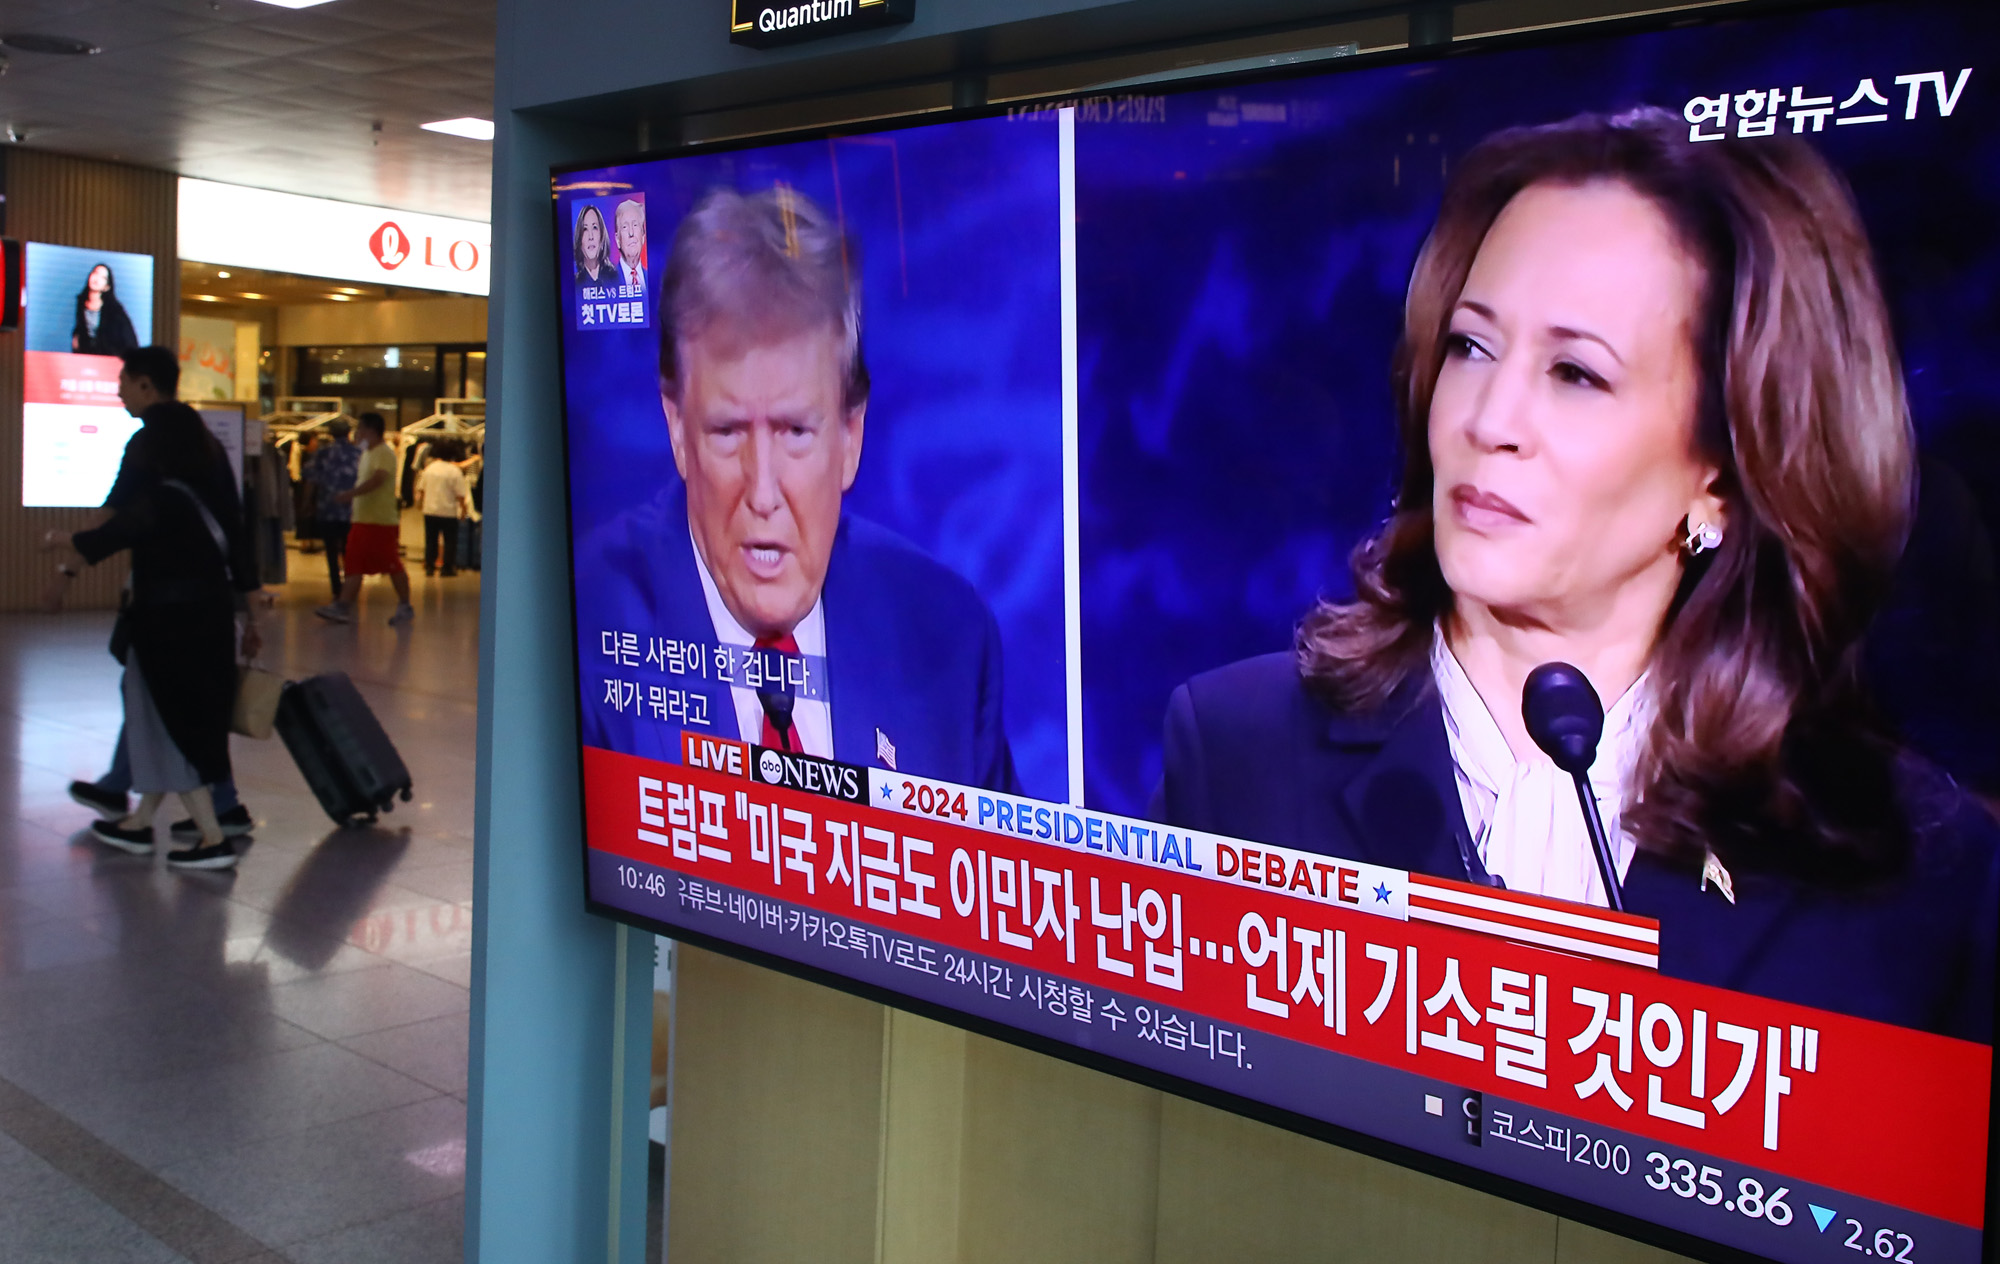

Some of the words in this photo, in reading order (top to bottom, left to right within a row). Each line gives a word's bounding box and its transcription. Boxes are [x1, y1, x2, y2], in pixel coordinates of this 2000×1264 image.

[759, 0, 853, 33] Quantum
[1683, 67, 1973, 143] 연합뉴스TV
[424, 236, 491, 272] LO
[581, 303, 596, 325] 첫
[595, 301, 644, 324] TV토론
[582, 285, 606, 300] 해리스
[618, 284, 643, 298] 트럼프
[601, 630, 640, 667] 다른
[645, 636, 707, 679] 사람이
[713, 644, 736, 683] 한
[742, 650, 817, 696] 겁니다.
[603, 678, 643, 717] 제가
[648, 685, 711, 726] 뭐라고
[687, 736, 743, 776] LIVE
[783, 755, 860, 799] NEWS
[900, 781, 969, 822] 2024
[977, 795, 1203, 871] PRESIDENTIAL
[1215, 843, 1361, 905] DEBATE
[617, 864, 667, 898] 10:46
[637, 775, 732, 864] 트럼프
[735, 790, 818, 895] "미국
[825, 818, 942, 920] 지금도
[949, 846, 1081, 964] 이민자
[1362, 941, 1549, 1090] 기소될
[1567, 985, 1820, 1153] 것인가"
[943, 952, 1014, 1000] 24시간
[1019, 969, 1095, 1024] 시청할
[1100, 1002, 1128, 1032] 수
[1135, 1004, 1254, 1070] 있습니다.
[1489, 1109, 1632, 1177] 코스피200
[1644, 1151, 1794, 1228] 335.86
[1843, 1218, 1916, 1264] 2.62
